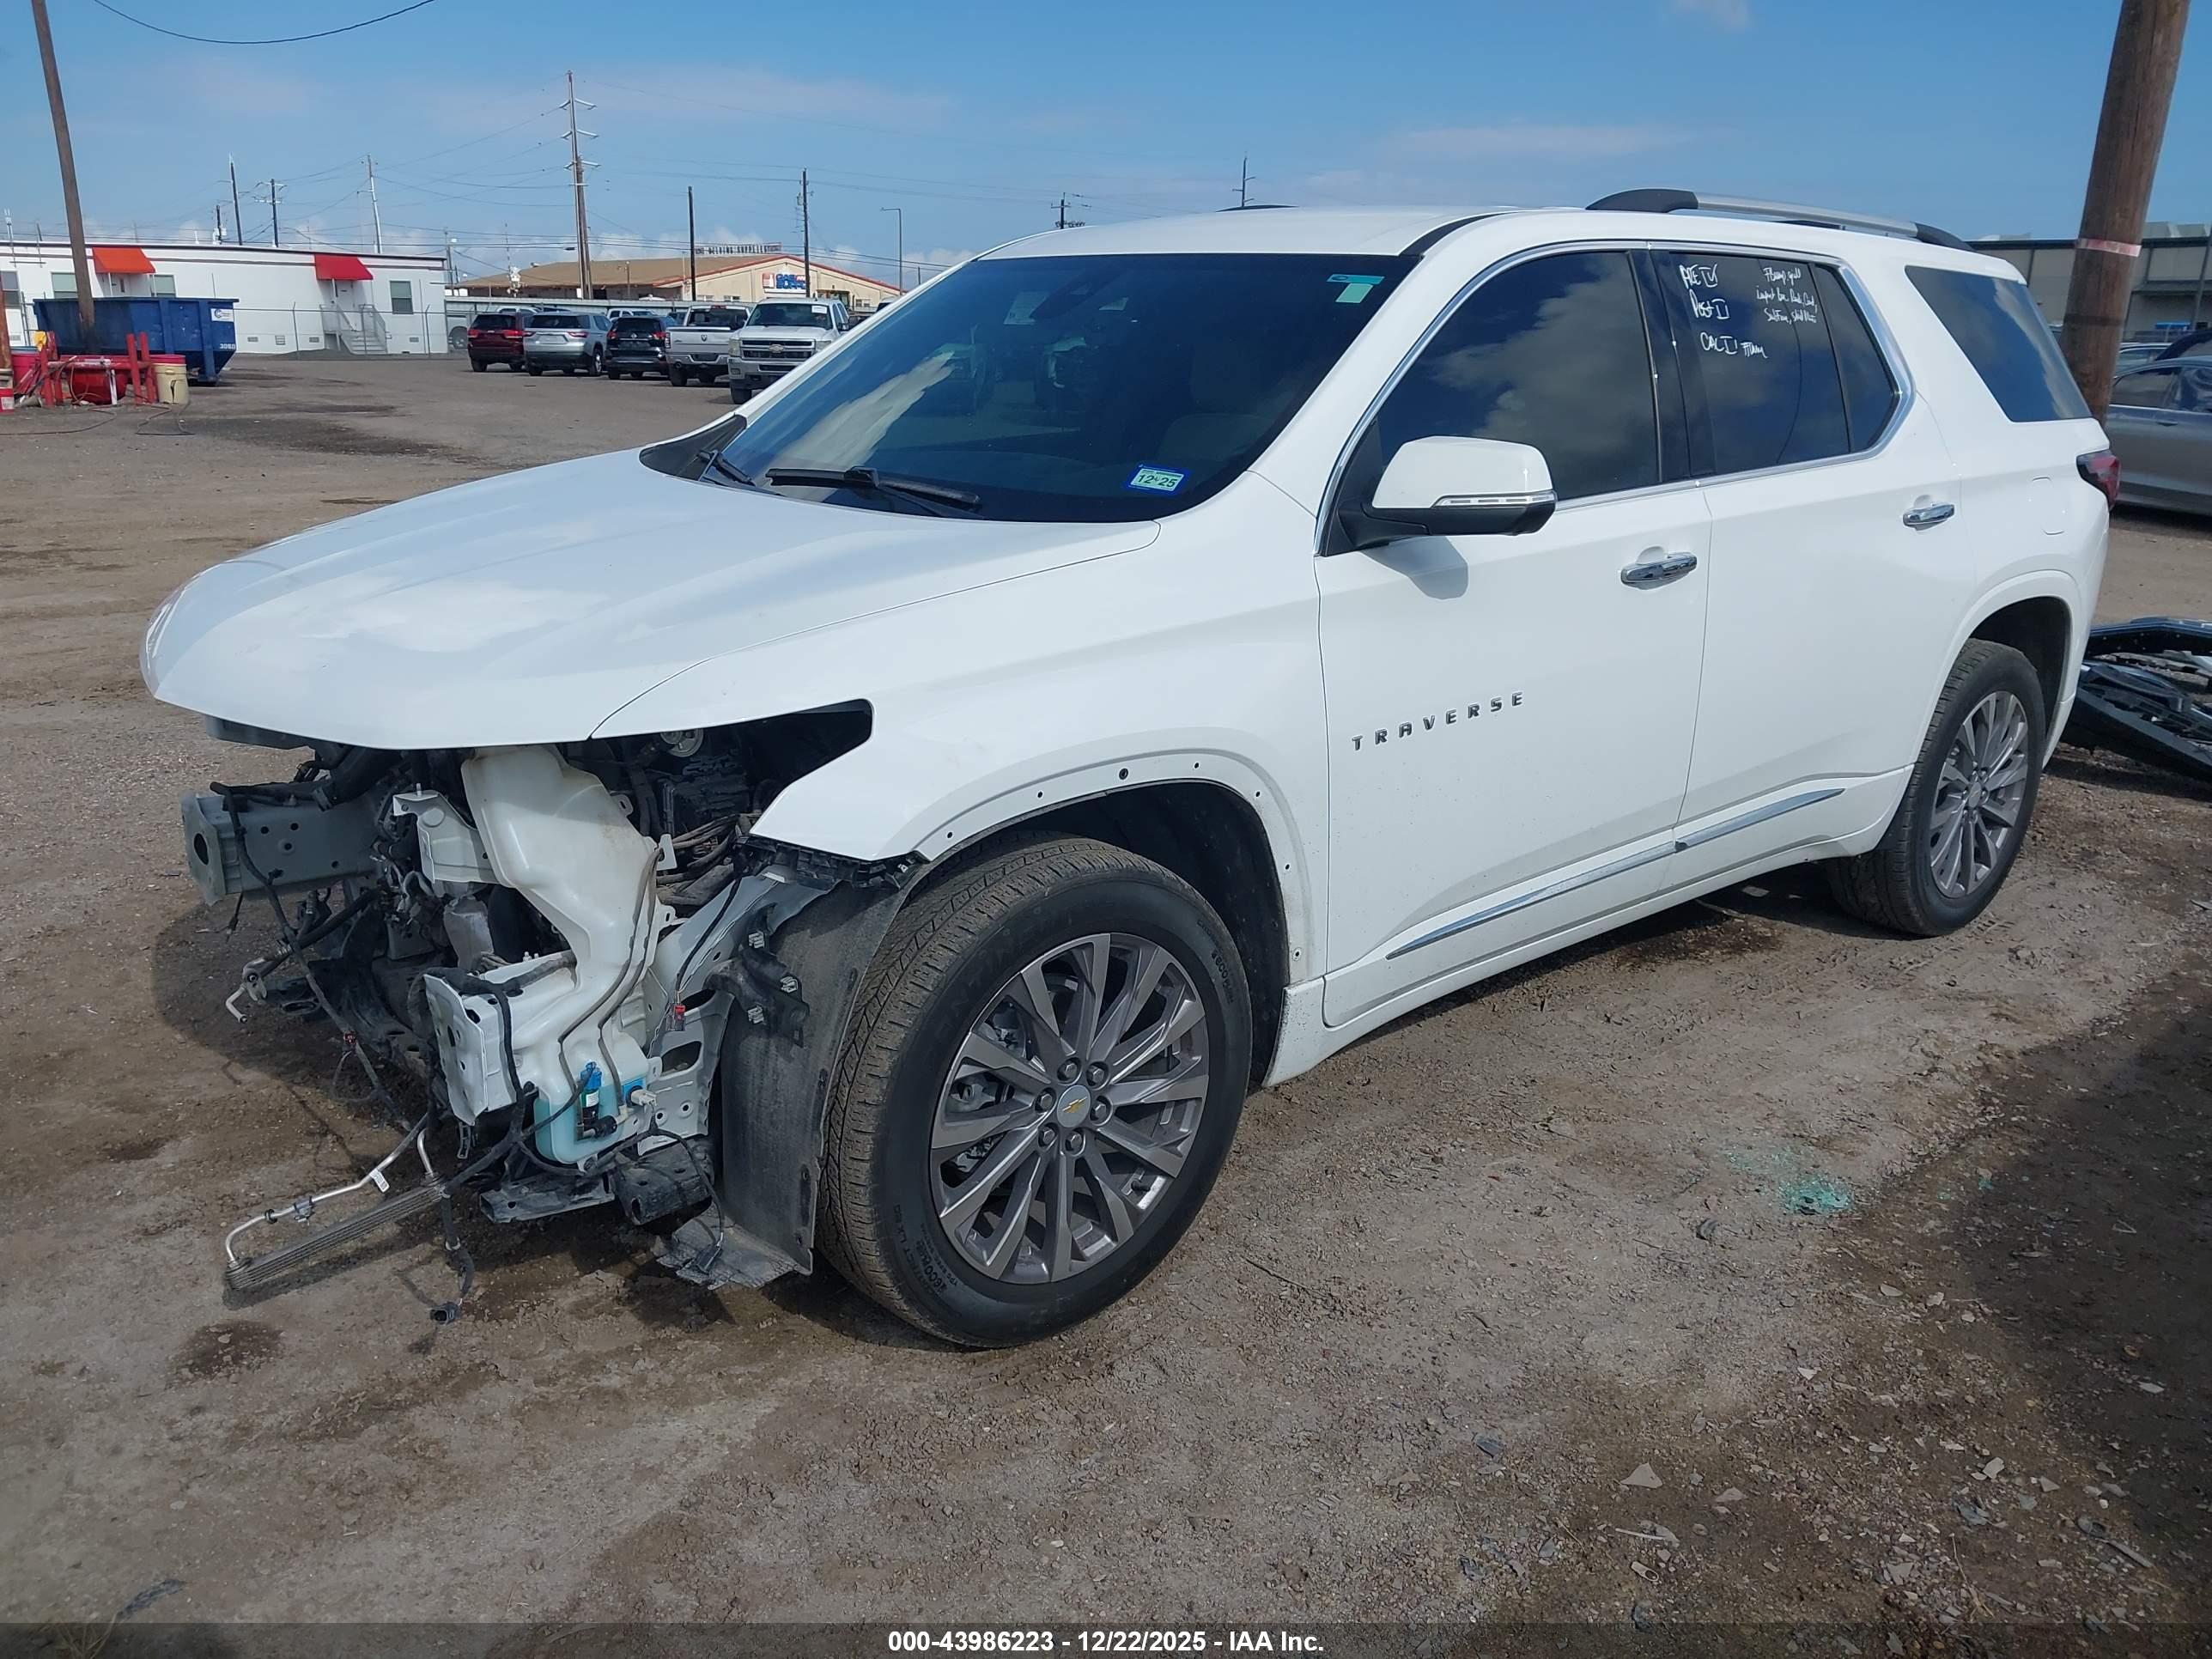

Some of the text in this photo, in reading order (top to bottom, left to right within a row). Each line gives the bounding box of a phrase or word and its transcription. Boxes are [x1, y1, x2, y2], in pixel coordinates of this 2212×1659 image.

[1138, 474, 1178, 488] 12 25
[1351, 691, 1523, 751] TRAVERSE
